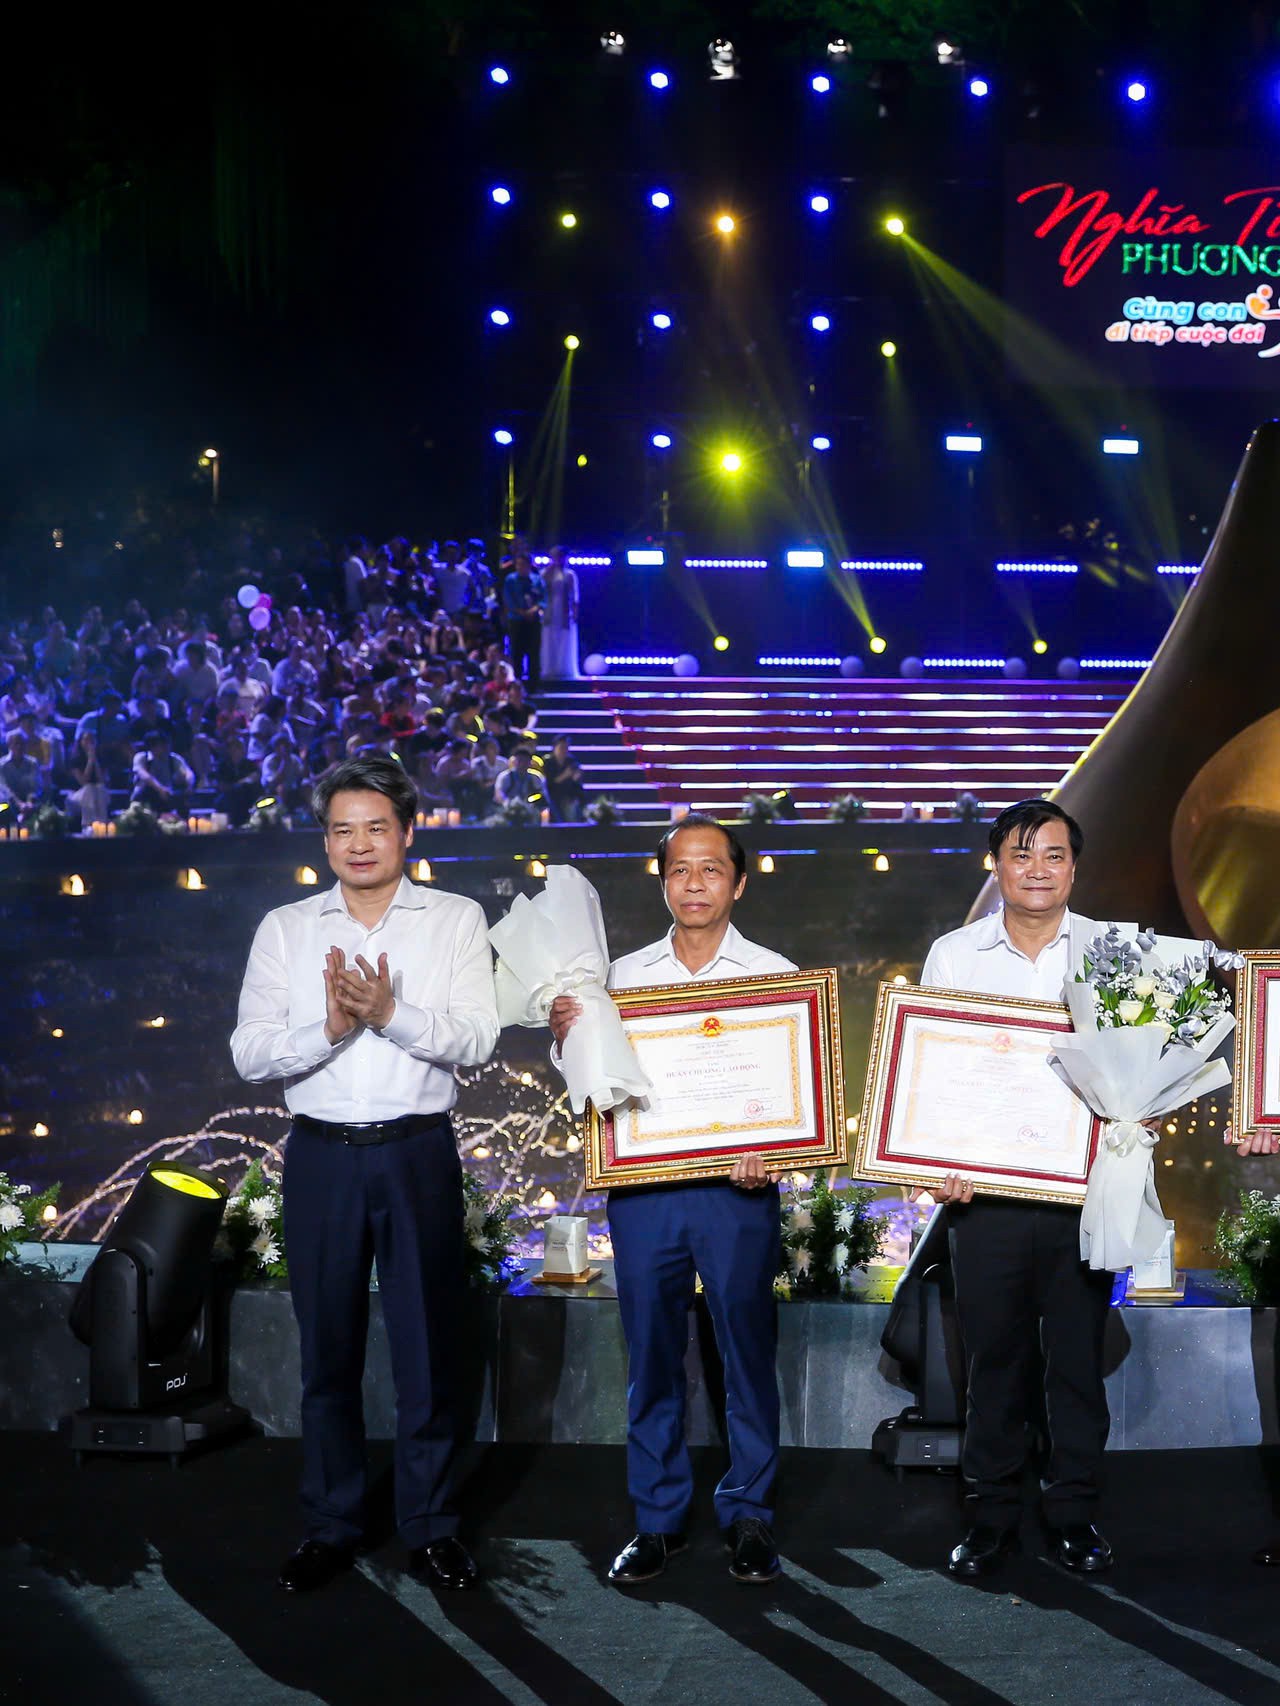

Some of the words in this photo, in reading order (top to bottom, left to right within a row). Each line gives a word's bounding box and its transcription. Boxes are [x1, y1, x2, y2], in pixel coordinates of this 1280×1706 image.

[1124, 296, 1194, 324] Cùng
[1198, 302, 1246, 322] con
[1174, 326, 1226, 347] cuộc
